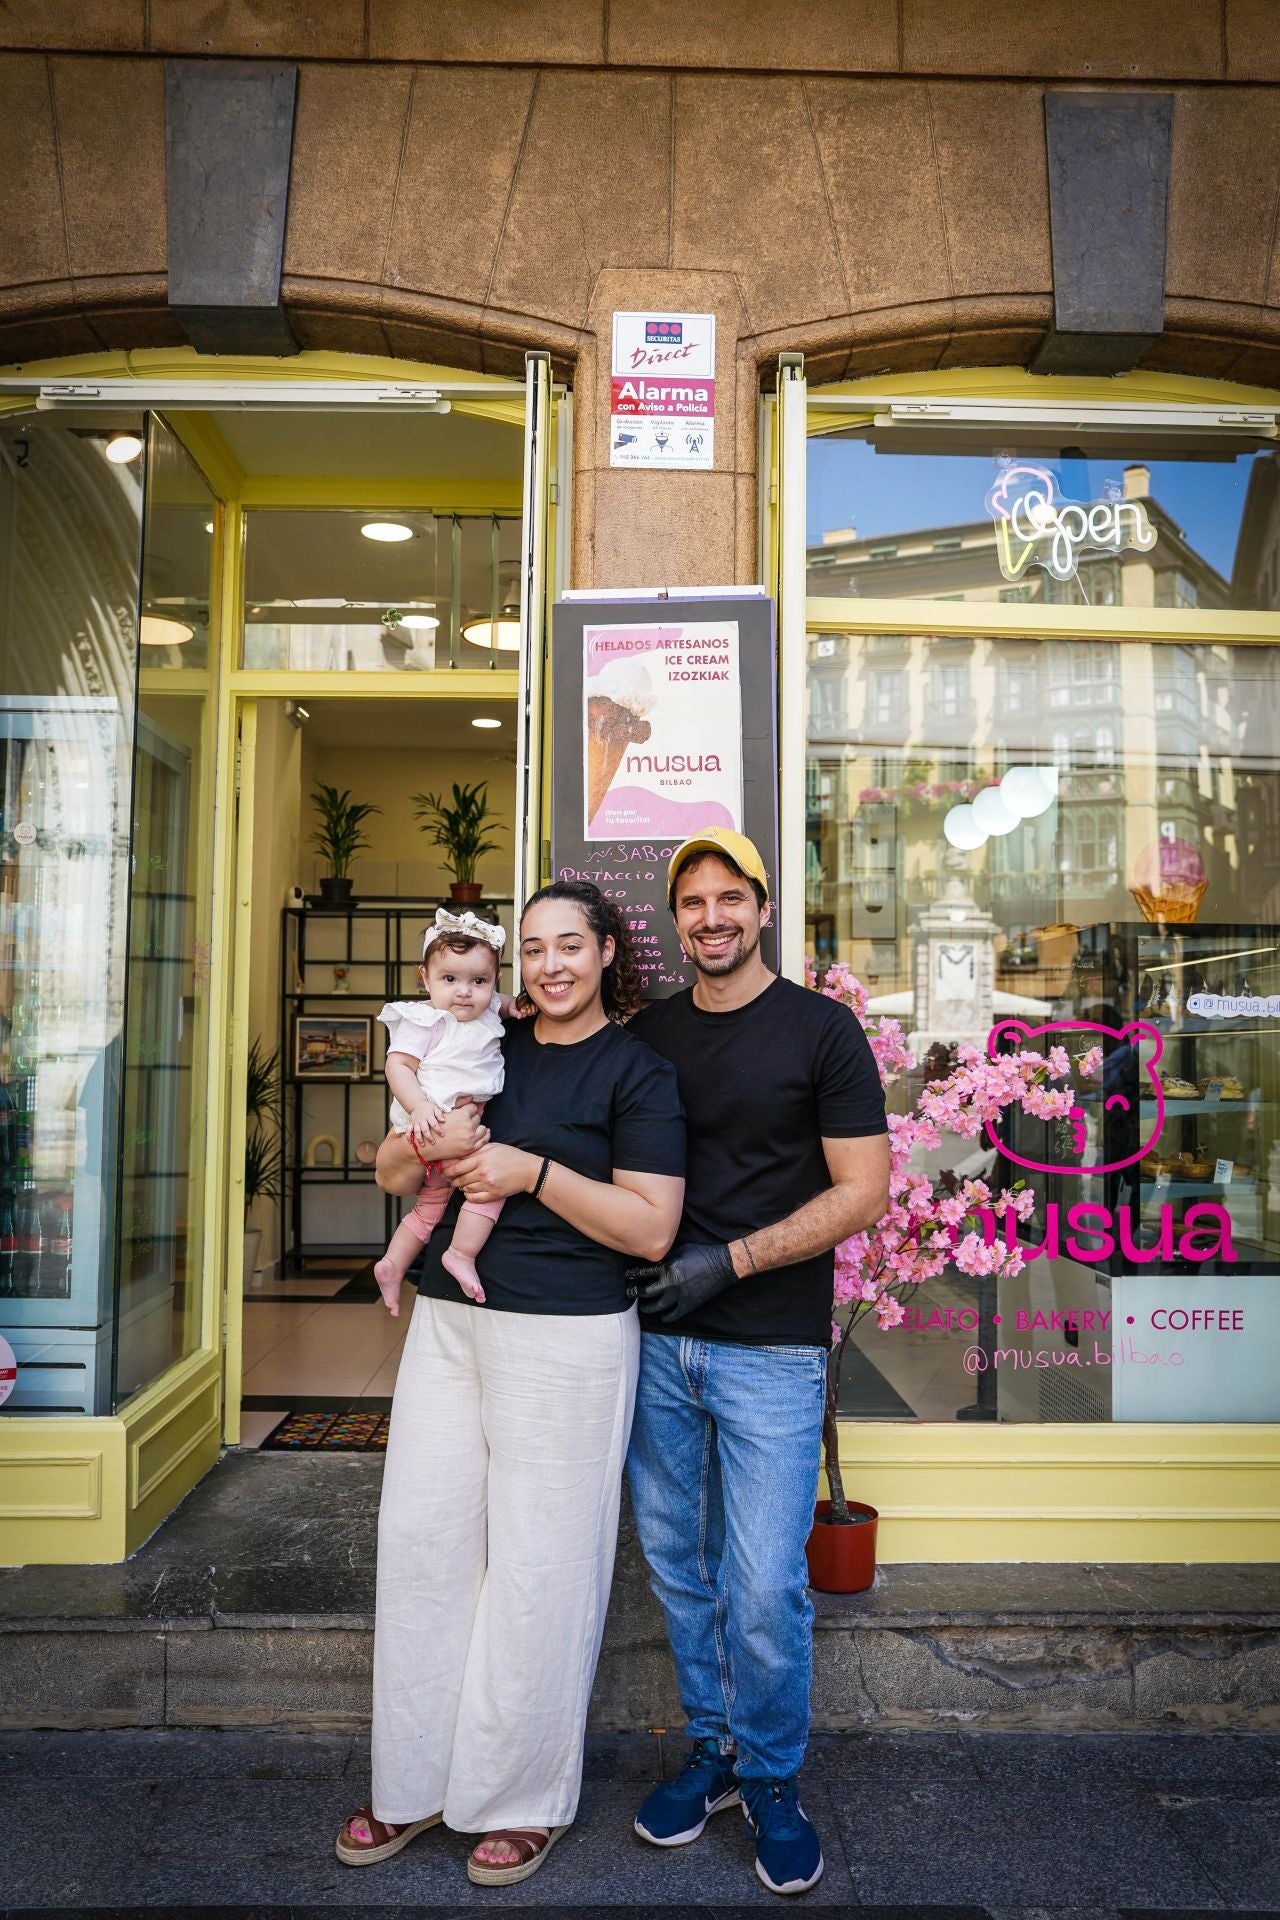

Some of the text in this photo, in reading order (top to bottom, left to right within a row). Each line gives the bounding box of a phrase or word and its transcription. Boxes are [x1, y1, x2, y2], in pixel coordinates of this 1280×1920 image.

[647, 335, 681, 343] SECURITAS
[629, 342, 701, 369] Direct
[618, 380, 709, 402] Alarma
[617, 403, 708, 413] con Aviso a Policía
[1011, 490, 1153, 574] Open
[595, 638, 730, 652] HELADOS ARTESANOS
[665, 654, 730, 666] ICE CREAM
[668, 670, 730, 682] IZOZKIAK
[626, 754, 722, 773] musua
[659, 778, 692, 786] BILBAO
[624, 808, 638, 817] por
[606, 817, 615, 825] tu
[614, 844, 681, 863] SABO
[631, 936, 660, 944] ECHE
[658, 970, 685, 984] más
[878, 1307, 1245, 1332] ELATO BAKERY COFFEE
[962, 1335, 1186, 1377] @musua.bilbao
